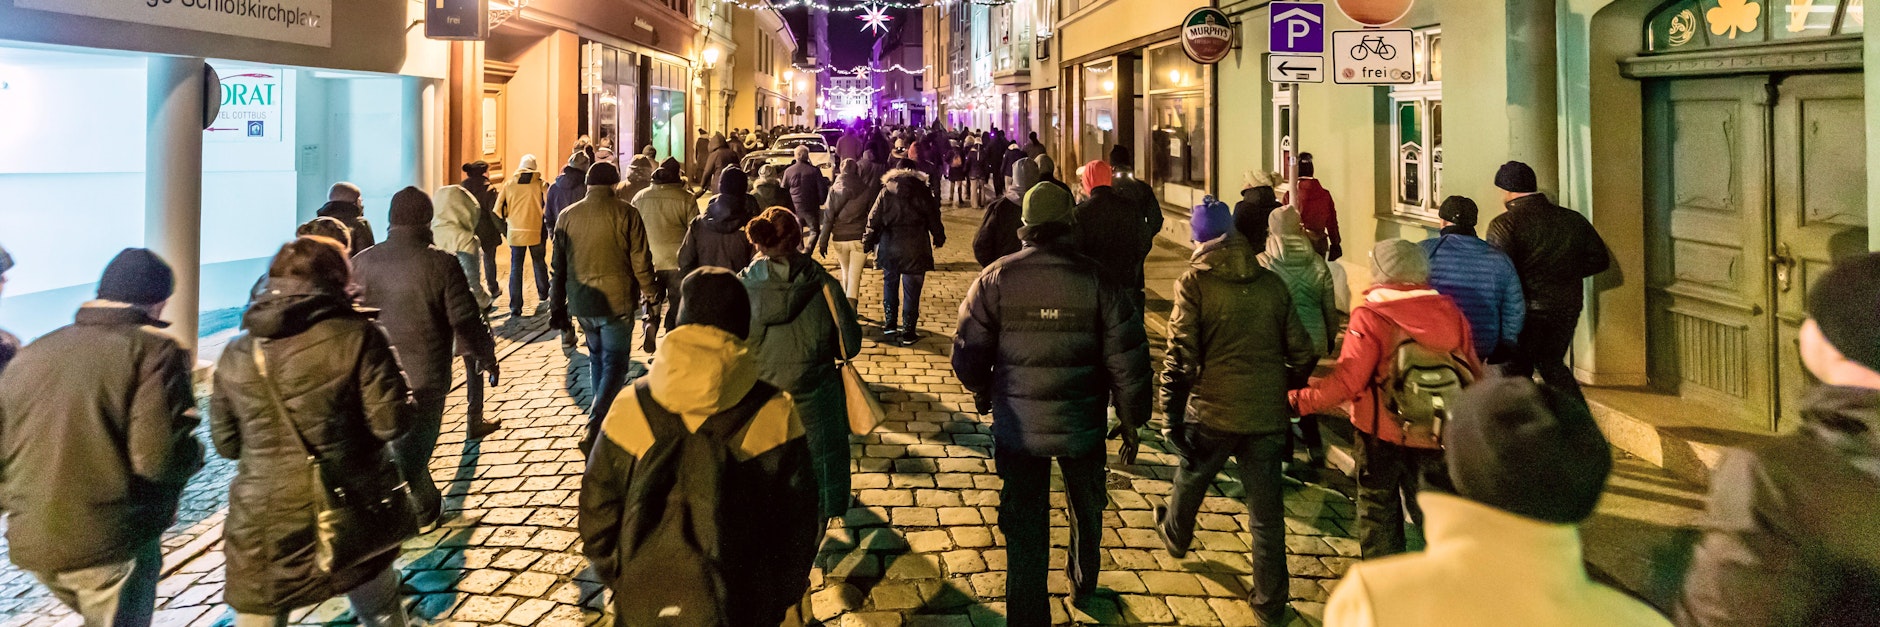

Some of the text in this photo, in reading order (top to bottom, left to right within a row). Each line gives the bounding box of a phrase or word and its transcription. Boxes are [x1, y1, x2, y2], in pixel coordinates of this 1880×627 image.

[446, 15, 460, 24] frei
[1287, 19, 1310, 48] P
[1361, 66, 1387, 78] frei
[232, 111, 267, 119] COTTBUS
[1040, 308, 1059, 320] HH
